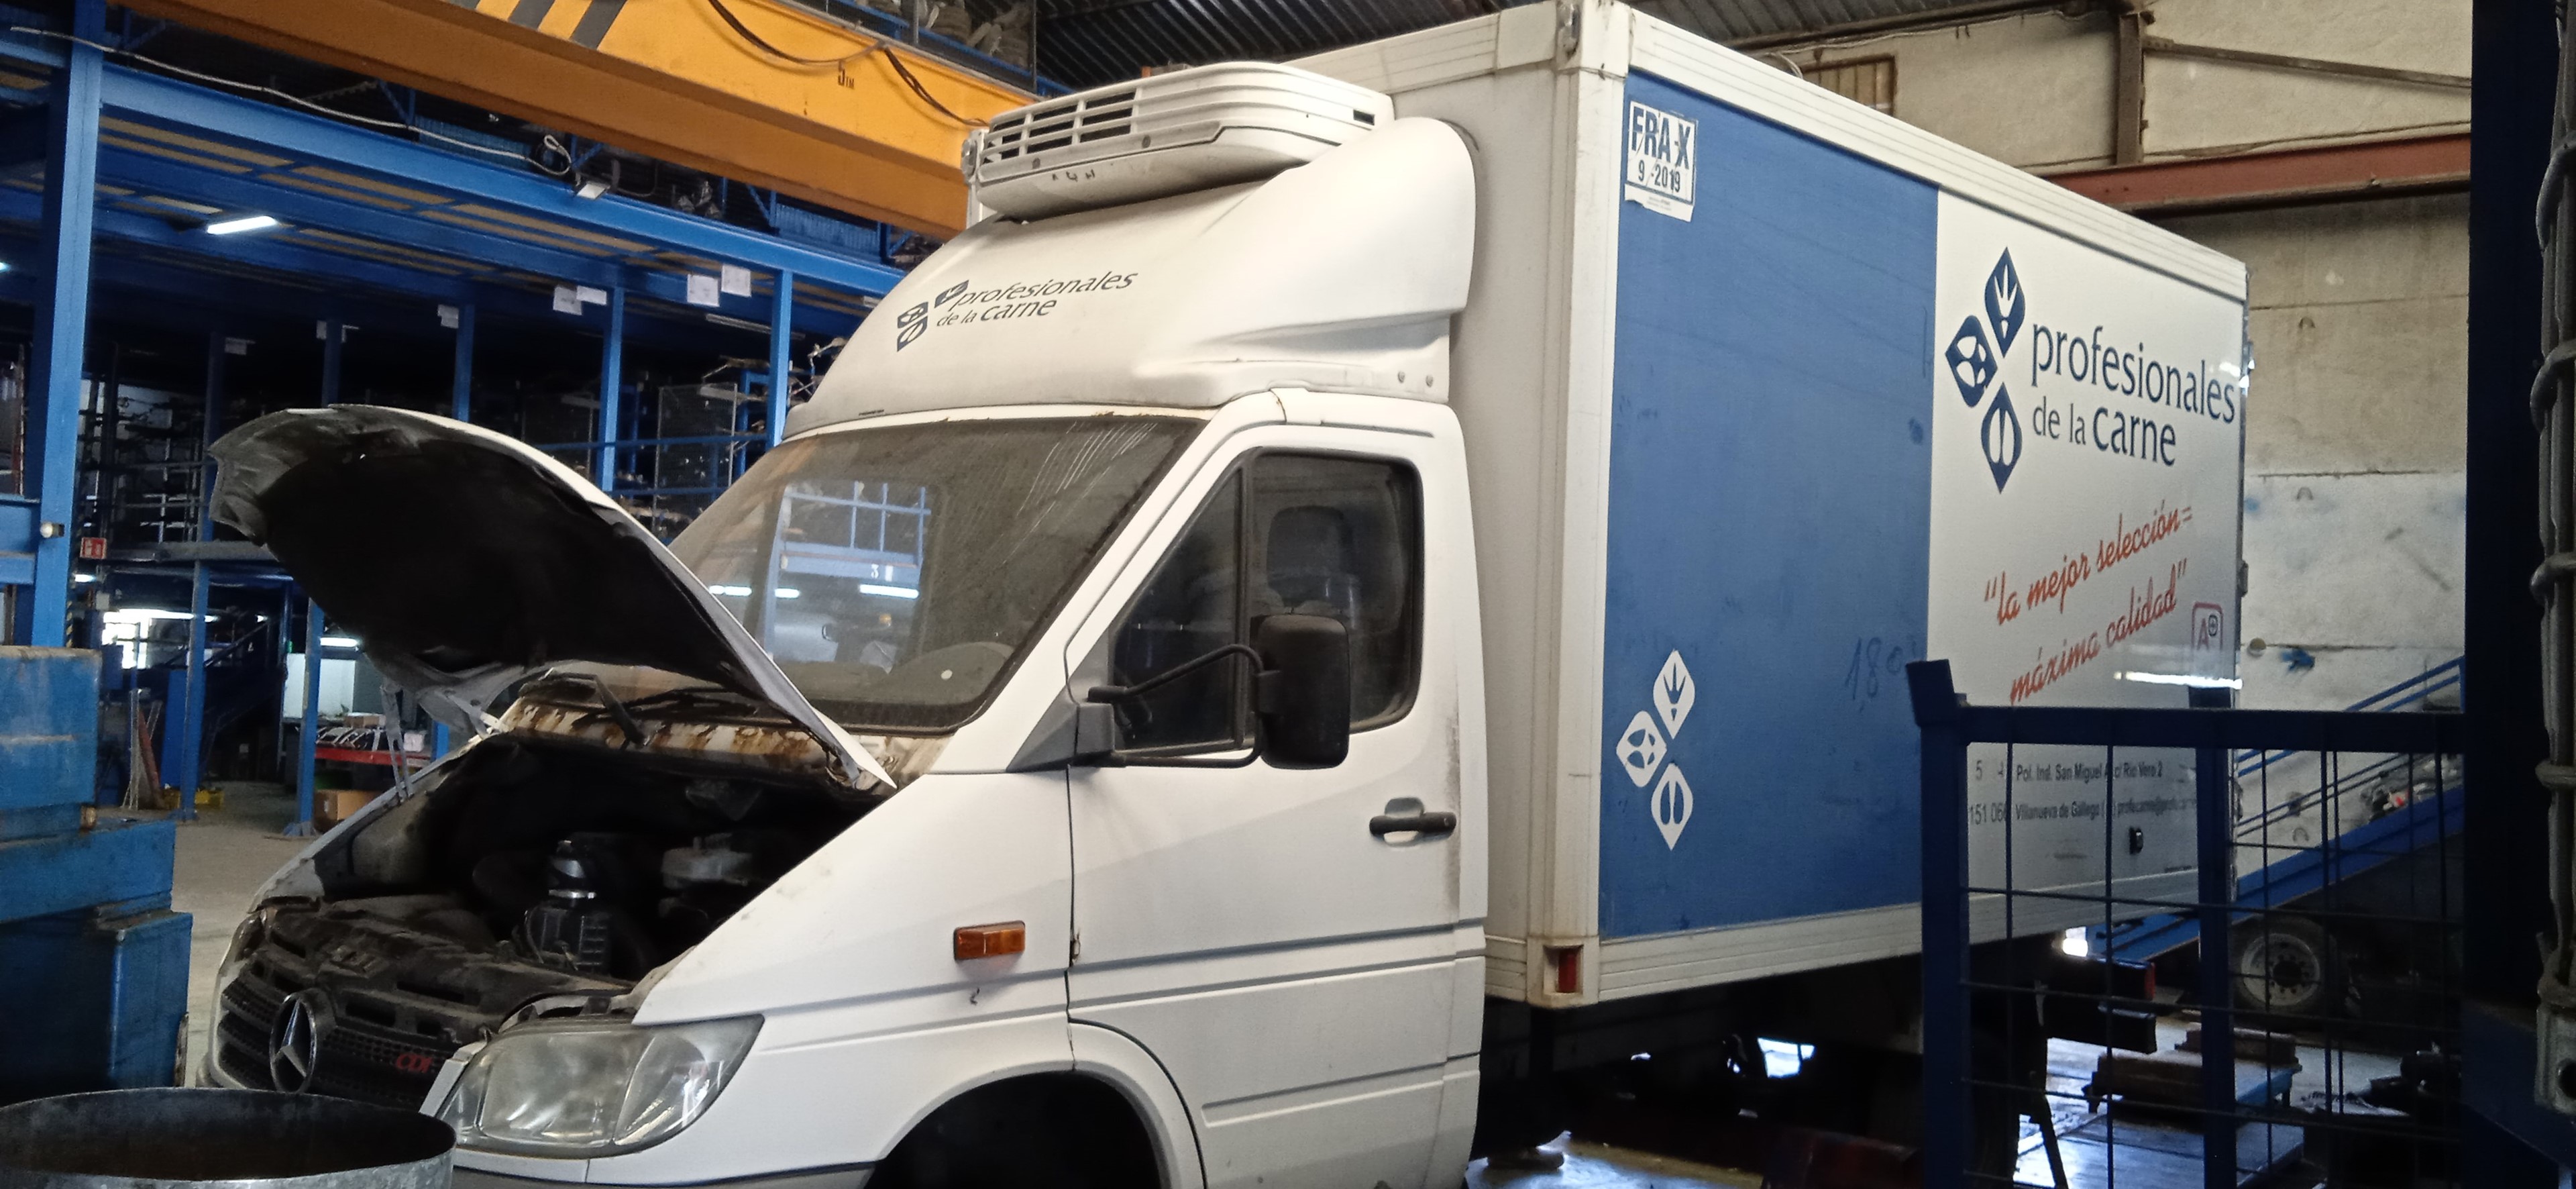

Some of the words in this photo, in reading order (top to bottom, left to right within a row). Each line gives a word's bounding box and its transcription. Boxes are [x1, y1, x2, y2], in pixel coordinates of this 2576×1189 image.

[936, 311, 959, 327] de
[961, 309, 977, 324] la
[980, 299, 1057, 322] carne
[948, 270, 1138, 312] profesionales
[2031, 323, 2235, 425] profesionales
[2032, 396, 2061, 440] de
[2069, 403, 2086, 446] la
[2093, 406, 2177, 466] carne
[2027, 553, 2091, 614] mejor
[2010, 631, 2101, 706] máxima
[2055, 764, 2073, 781] San
